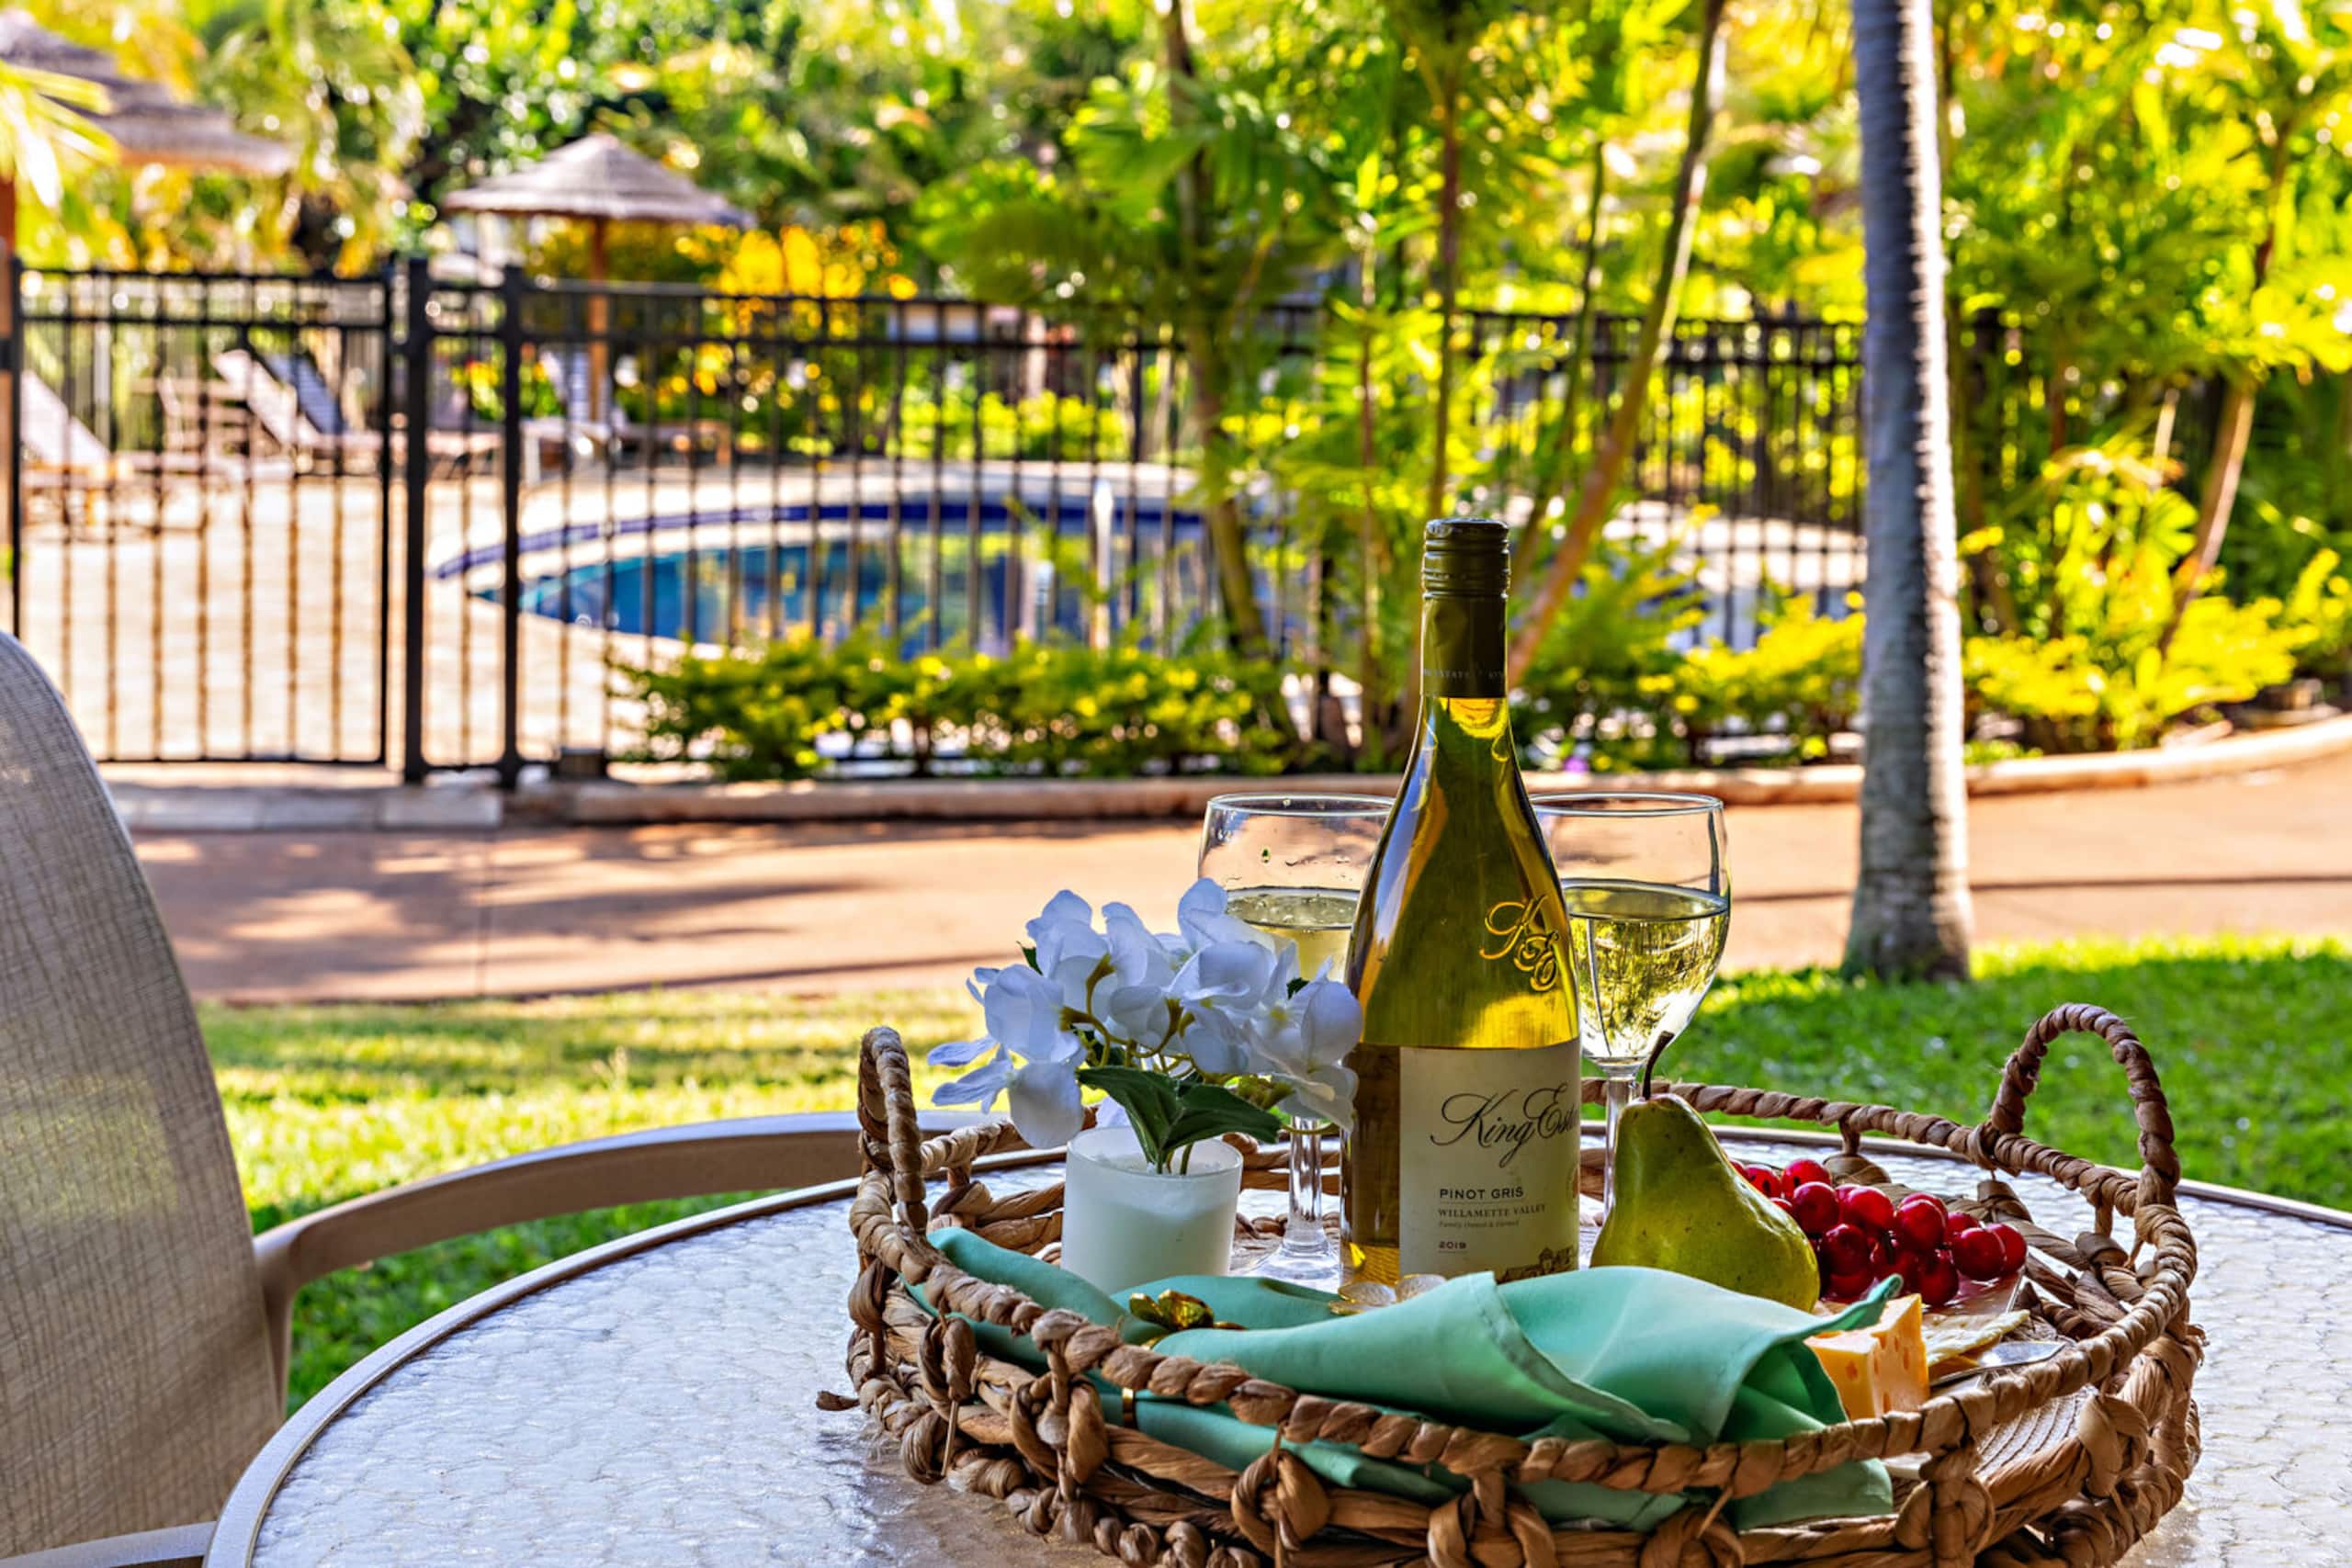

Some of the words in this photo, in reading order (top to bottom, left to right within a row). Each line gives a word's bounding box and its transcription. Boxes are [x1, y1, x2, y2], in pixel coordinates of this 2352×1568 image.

[1430, 1089, 1536, 1168] King
[1439, 1188, 1486, 1200] PINOT
[1490, 1186, 1524, 1199] GRIS
[1438, 1208, 1510, 1218] WILLAMETTE
[1513, 1203, 1545, 1215] VALLEY
